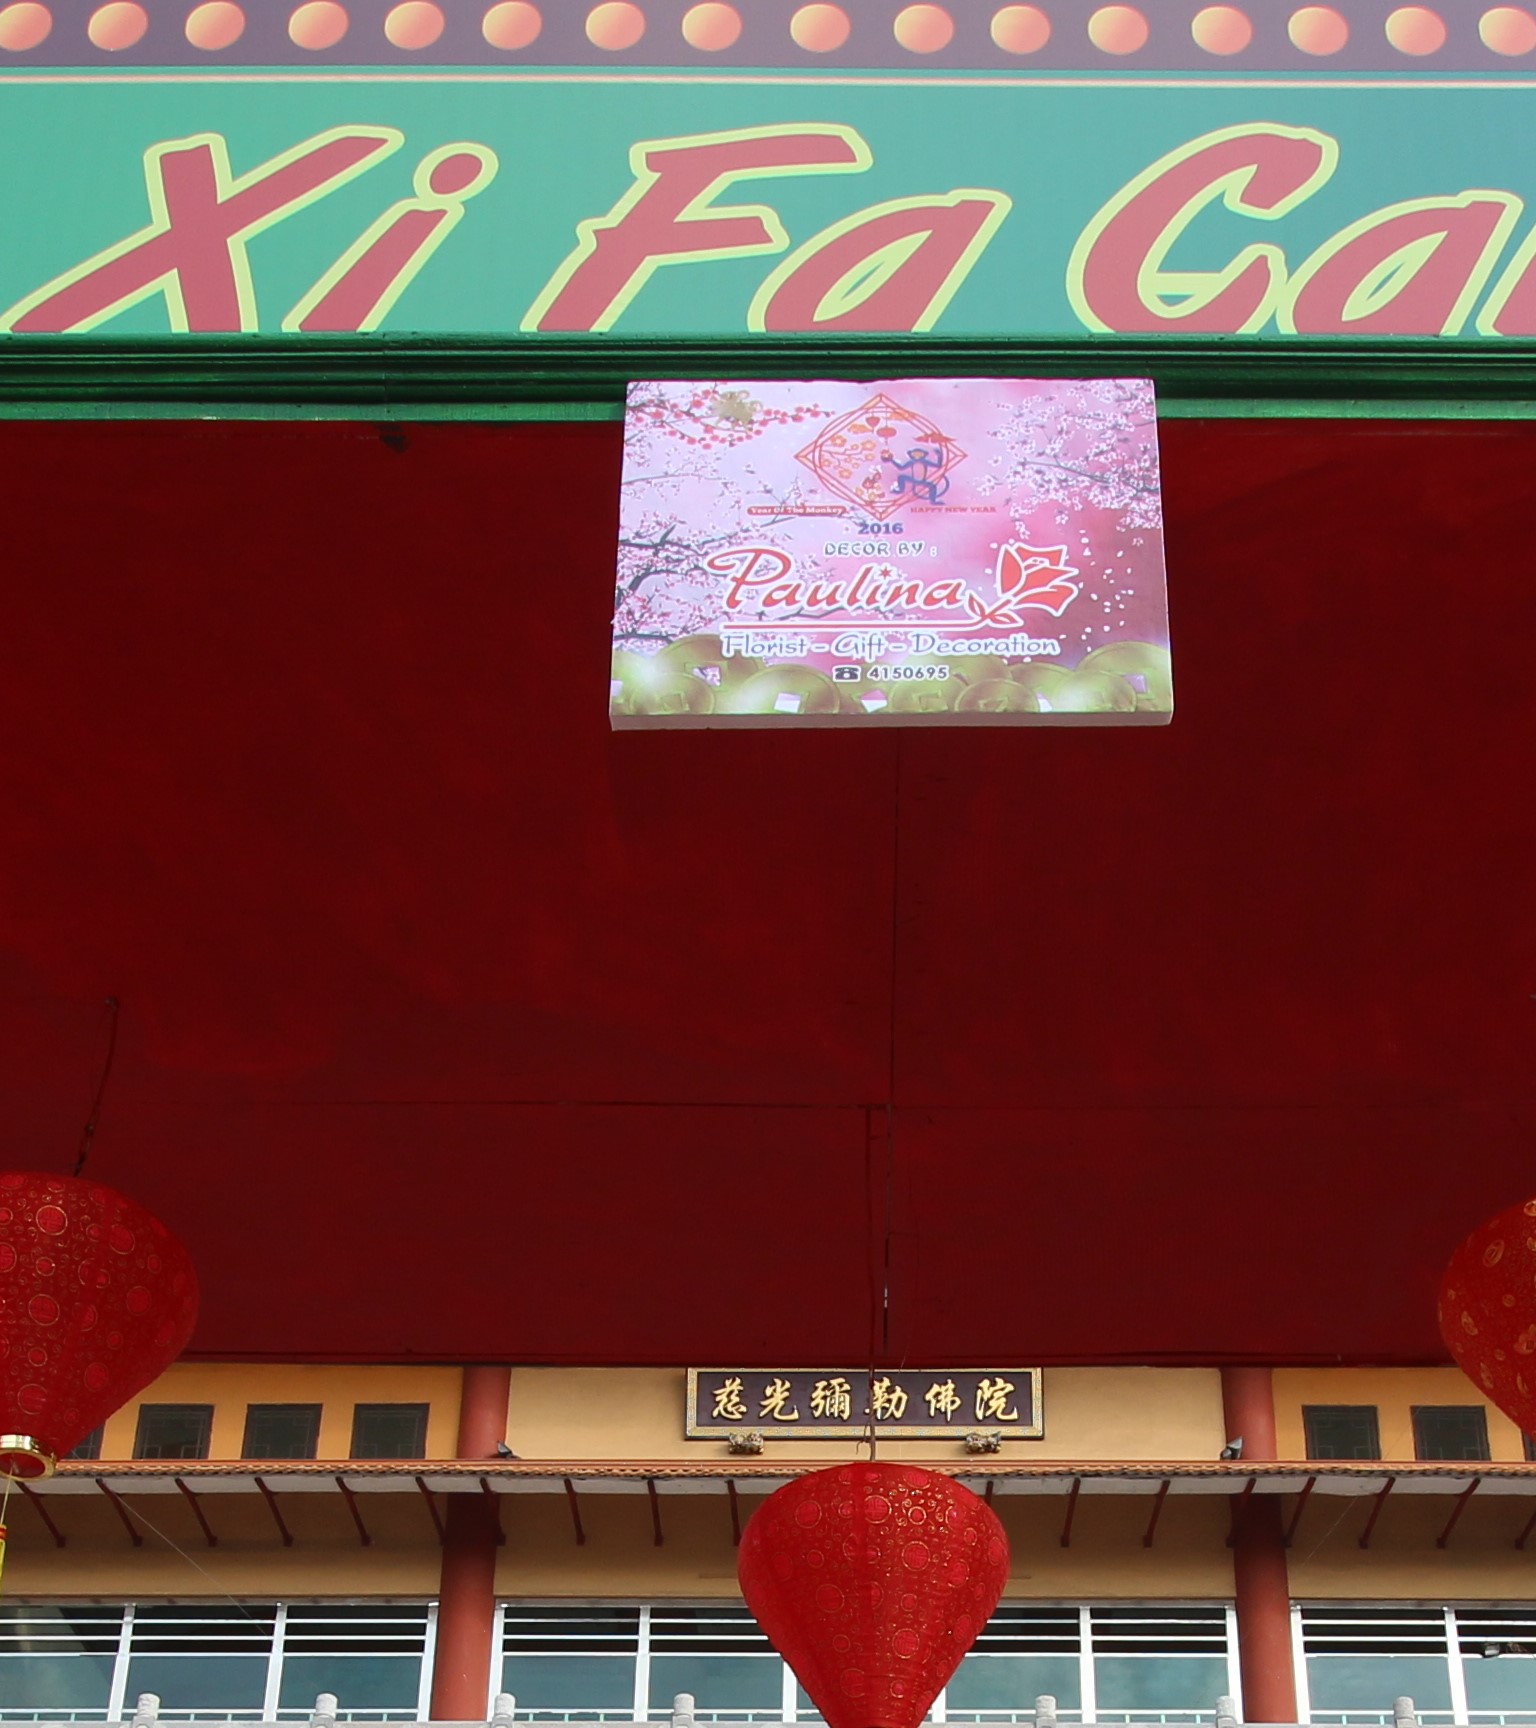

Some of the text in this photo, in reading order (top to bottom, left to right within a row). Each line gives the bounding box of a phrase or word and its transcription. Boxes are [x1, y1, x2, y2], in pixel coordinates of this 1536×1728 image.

[519, 122, 1013, 333] Fa
[751, 506, 771, 514] Year
[785, 506, 804, 514] The
[806, 507, 843, 516] Monkey
[858, 522, 904, 536] 2016
[824, 542, 889, 557] DECOR
[898, 542, 925, 556] BY
[706, 547, 967, 610] Paulina
[722, 632, 809, 657] Florist
[834, 632, 886, 661] Gift
[912, 632, 1061, 656] Decoration
[867, 666, 950, 681] 4150695
[711, 1376, 1019, 1423] 慈光彌勒佛院
